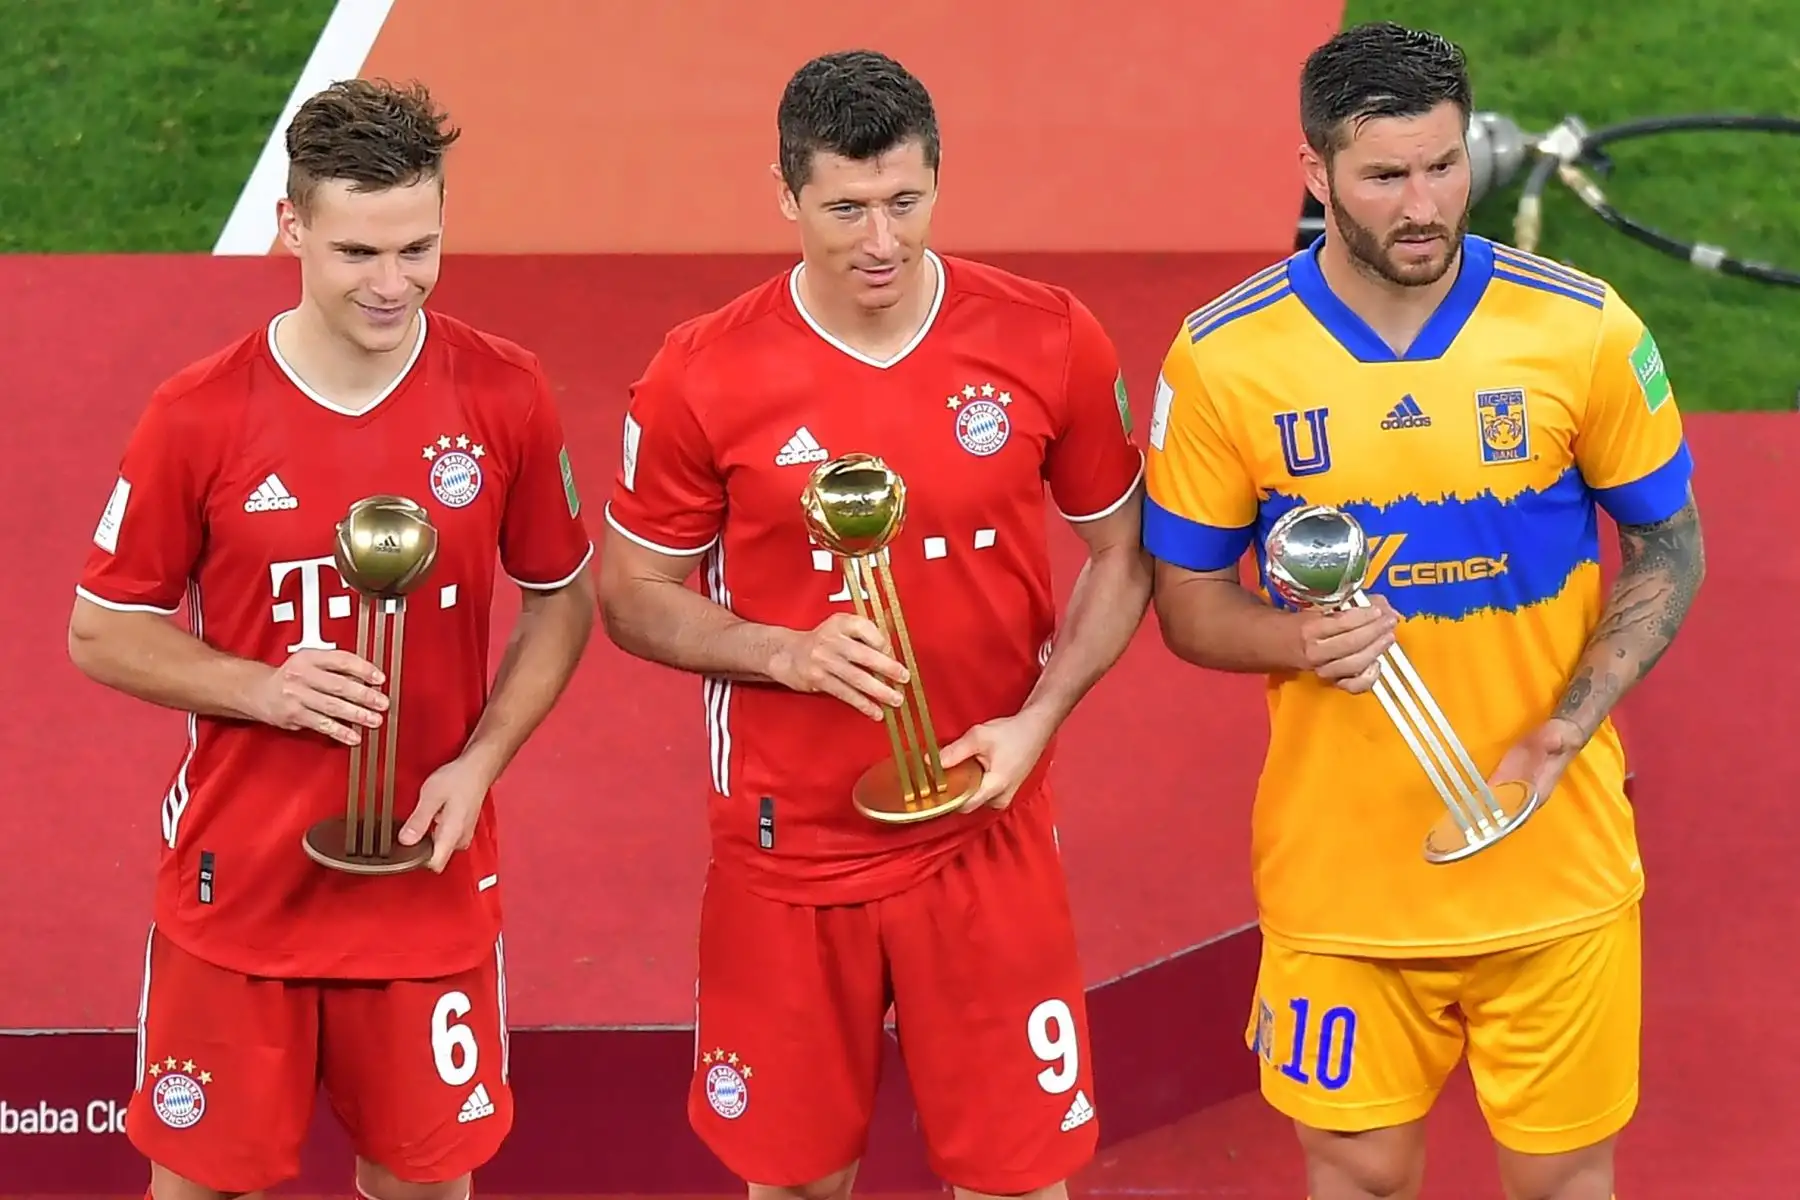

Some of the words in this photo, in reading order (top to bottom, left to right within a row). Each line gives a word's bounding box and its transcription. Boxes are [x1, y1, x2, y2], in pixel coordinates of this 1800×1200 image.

[1480, 392, 1522, 407] TIGRES
[969, 404, 1004, 423] BAYERN
[1380, 414, 1431, 430] adidas
[1273, 407, 1331, 477] U
[444, 455, 477, 475] BAYERN
[775, 447, 829, 466] adidas
[244, 496, 298, 513] adidas
[1388, 552, 1508, 587] CEMEX
[270, 555, 351, 653] T
[432, 991, 478, 1086] 6
[1027, 999, 1079, 1093] 9
[1281, 998, 1355, 1090] 10
[167, 1077, 201, 1100] BAYERN
[0, 1100, 79, 1134] baba
[457, 1102, 495, 1123] adidas
